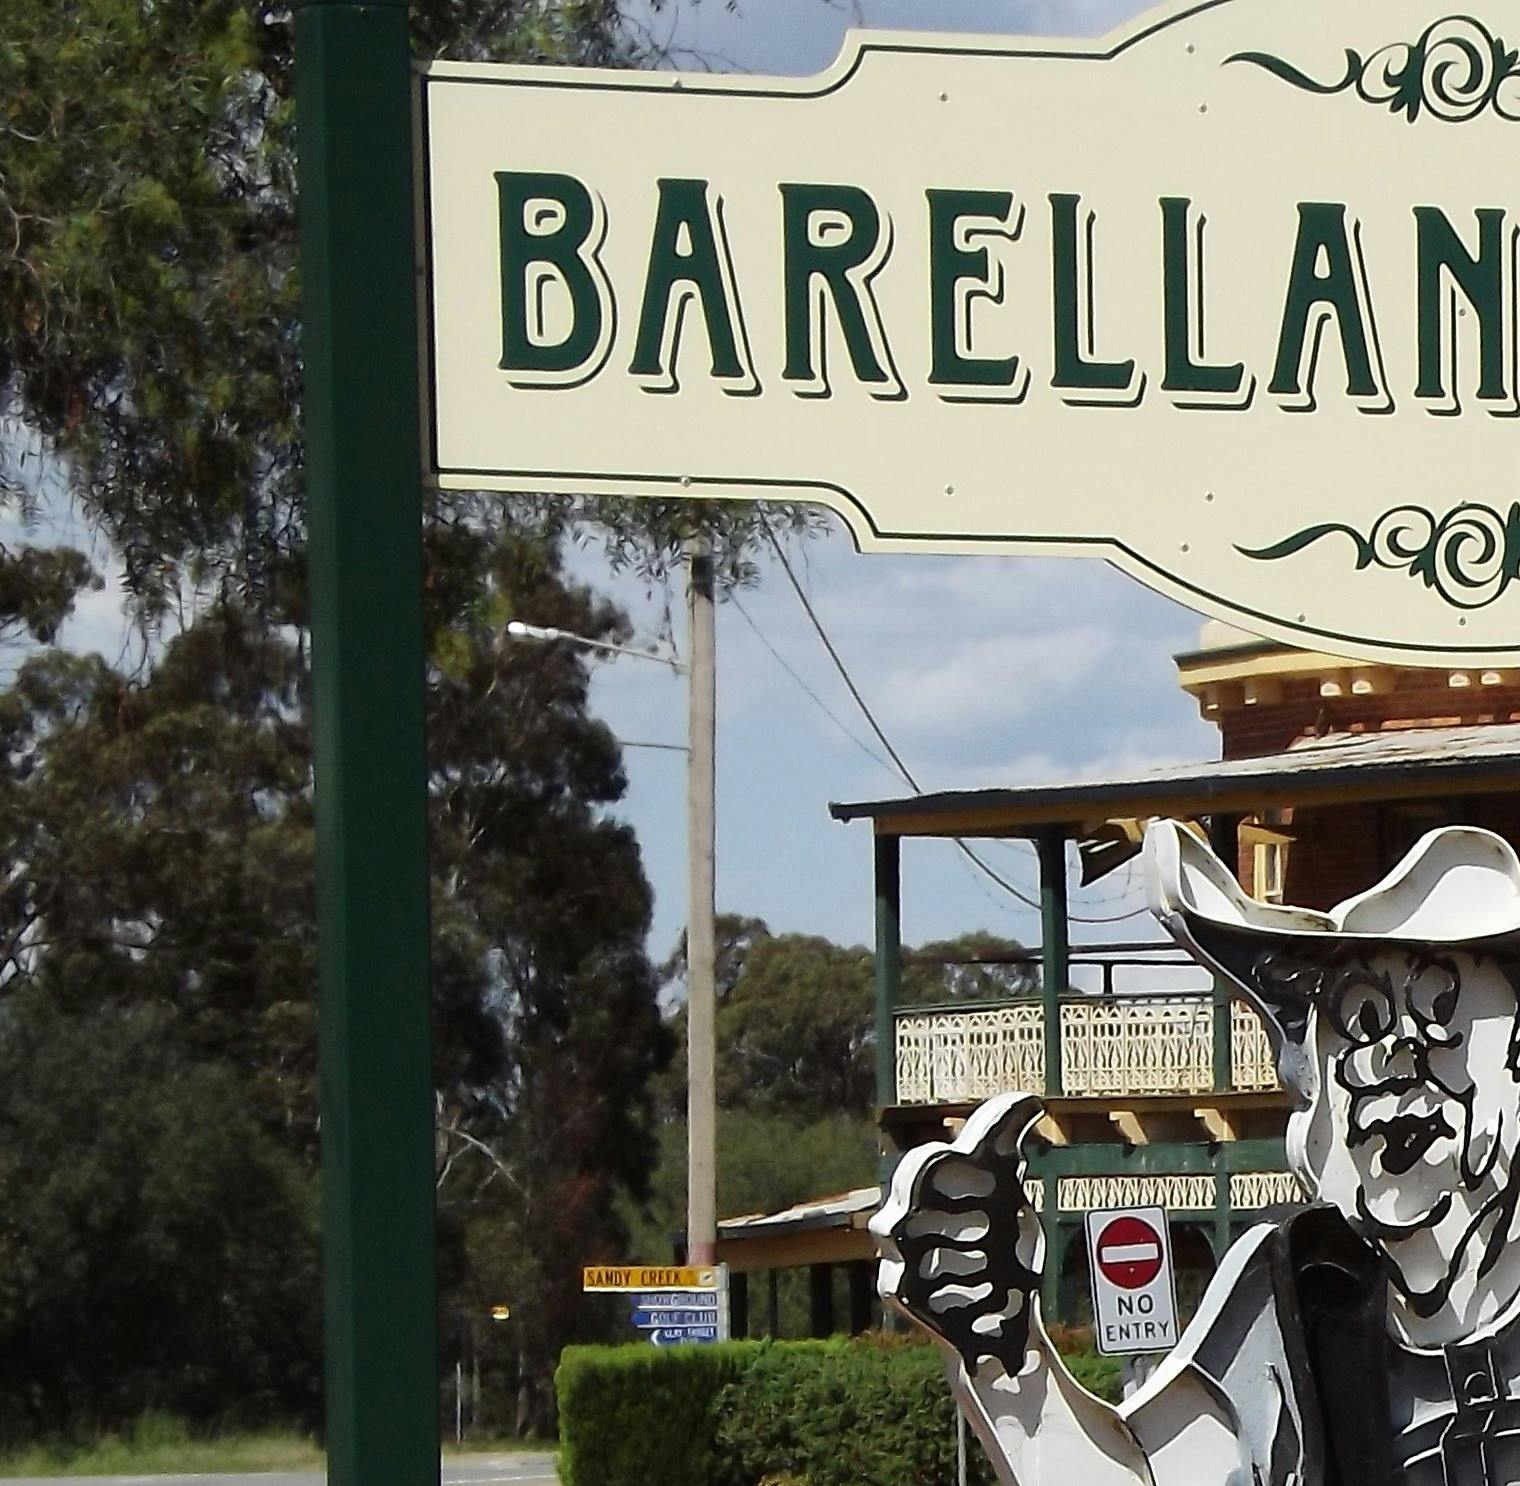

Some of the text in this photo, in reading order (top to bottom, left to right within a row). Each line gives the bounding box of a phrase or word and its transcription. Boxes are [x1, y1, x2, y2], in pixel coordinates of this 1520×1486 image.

[586, 1269, 681, 1286] SANDY CREEK
[1118, 1294, 1153, 1316] NO
[1106, 1321, 1169, 1342] ENTRY
